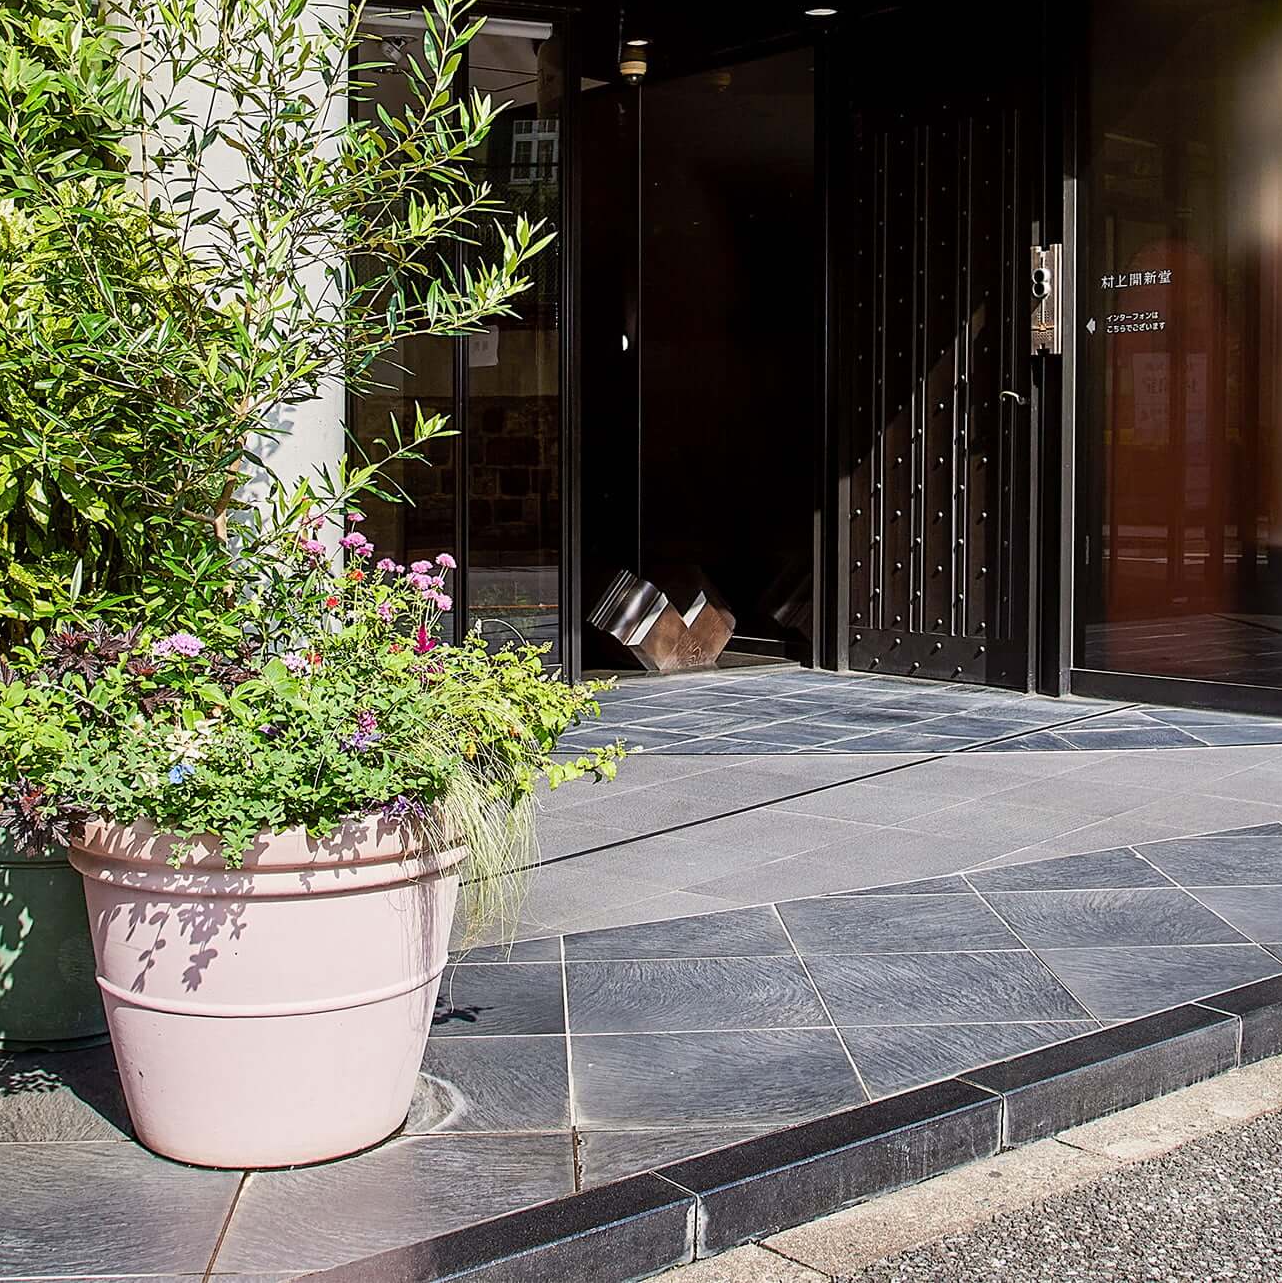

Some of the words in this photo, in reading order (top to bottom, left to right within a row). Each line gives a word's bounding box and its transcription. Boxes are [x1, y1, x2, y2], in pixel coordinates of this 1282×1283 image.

[1101, 269, 1173, 289] 村上開新堂
[1106, 311, 1159, 323] インターフォンは
[1106, 322, 1166, 334] こちらでございます
